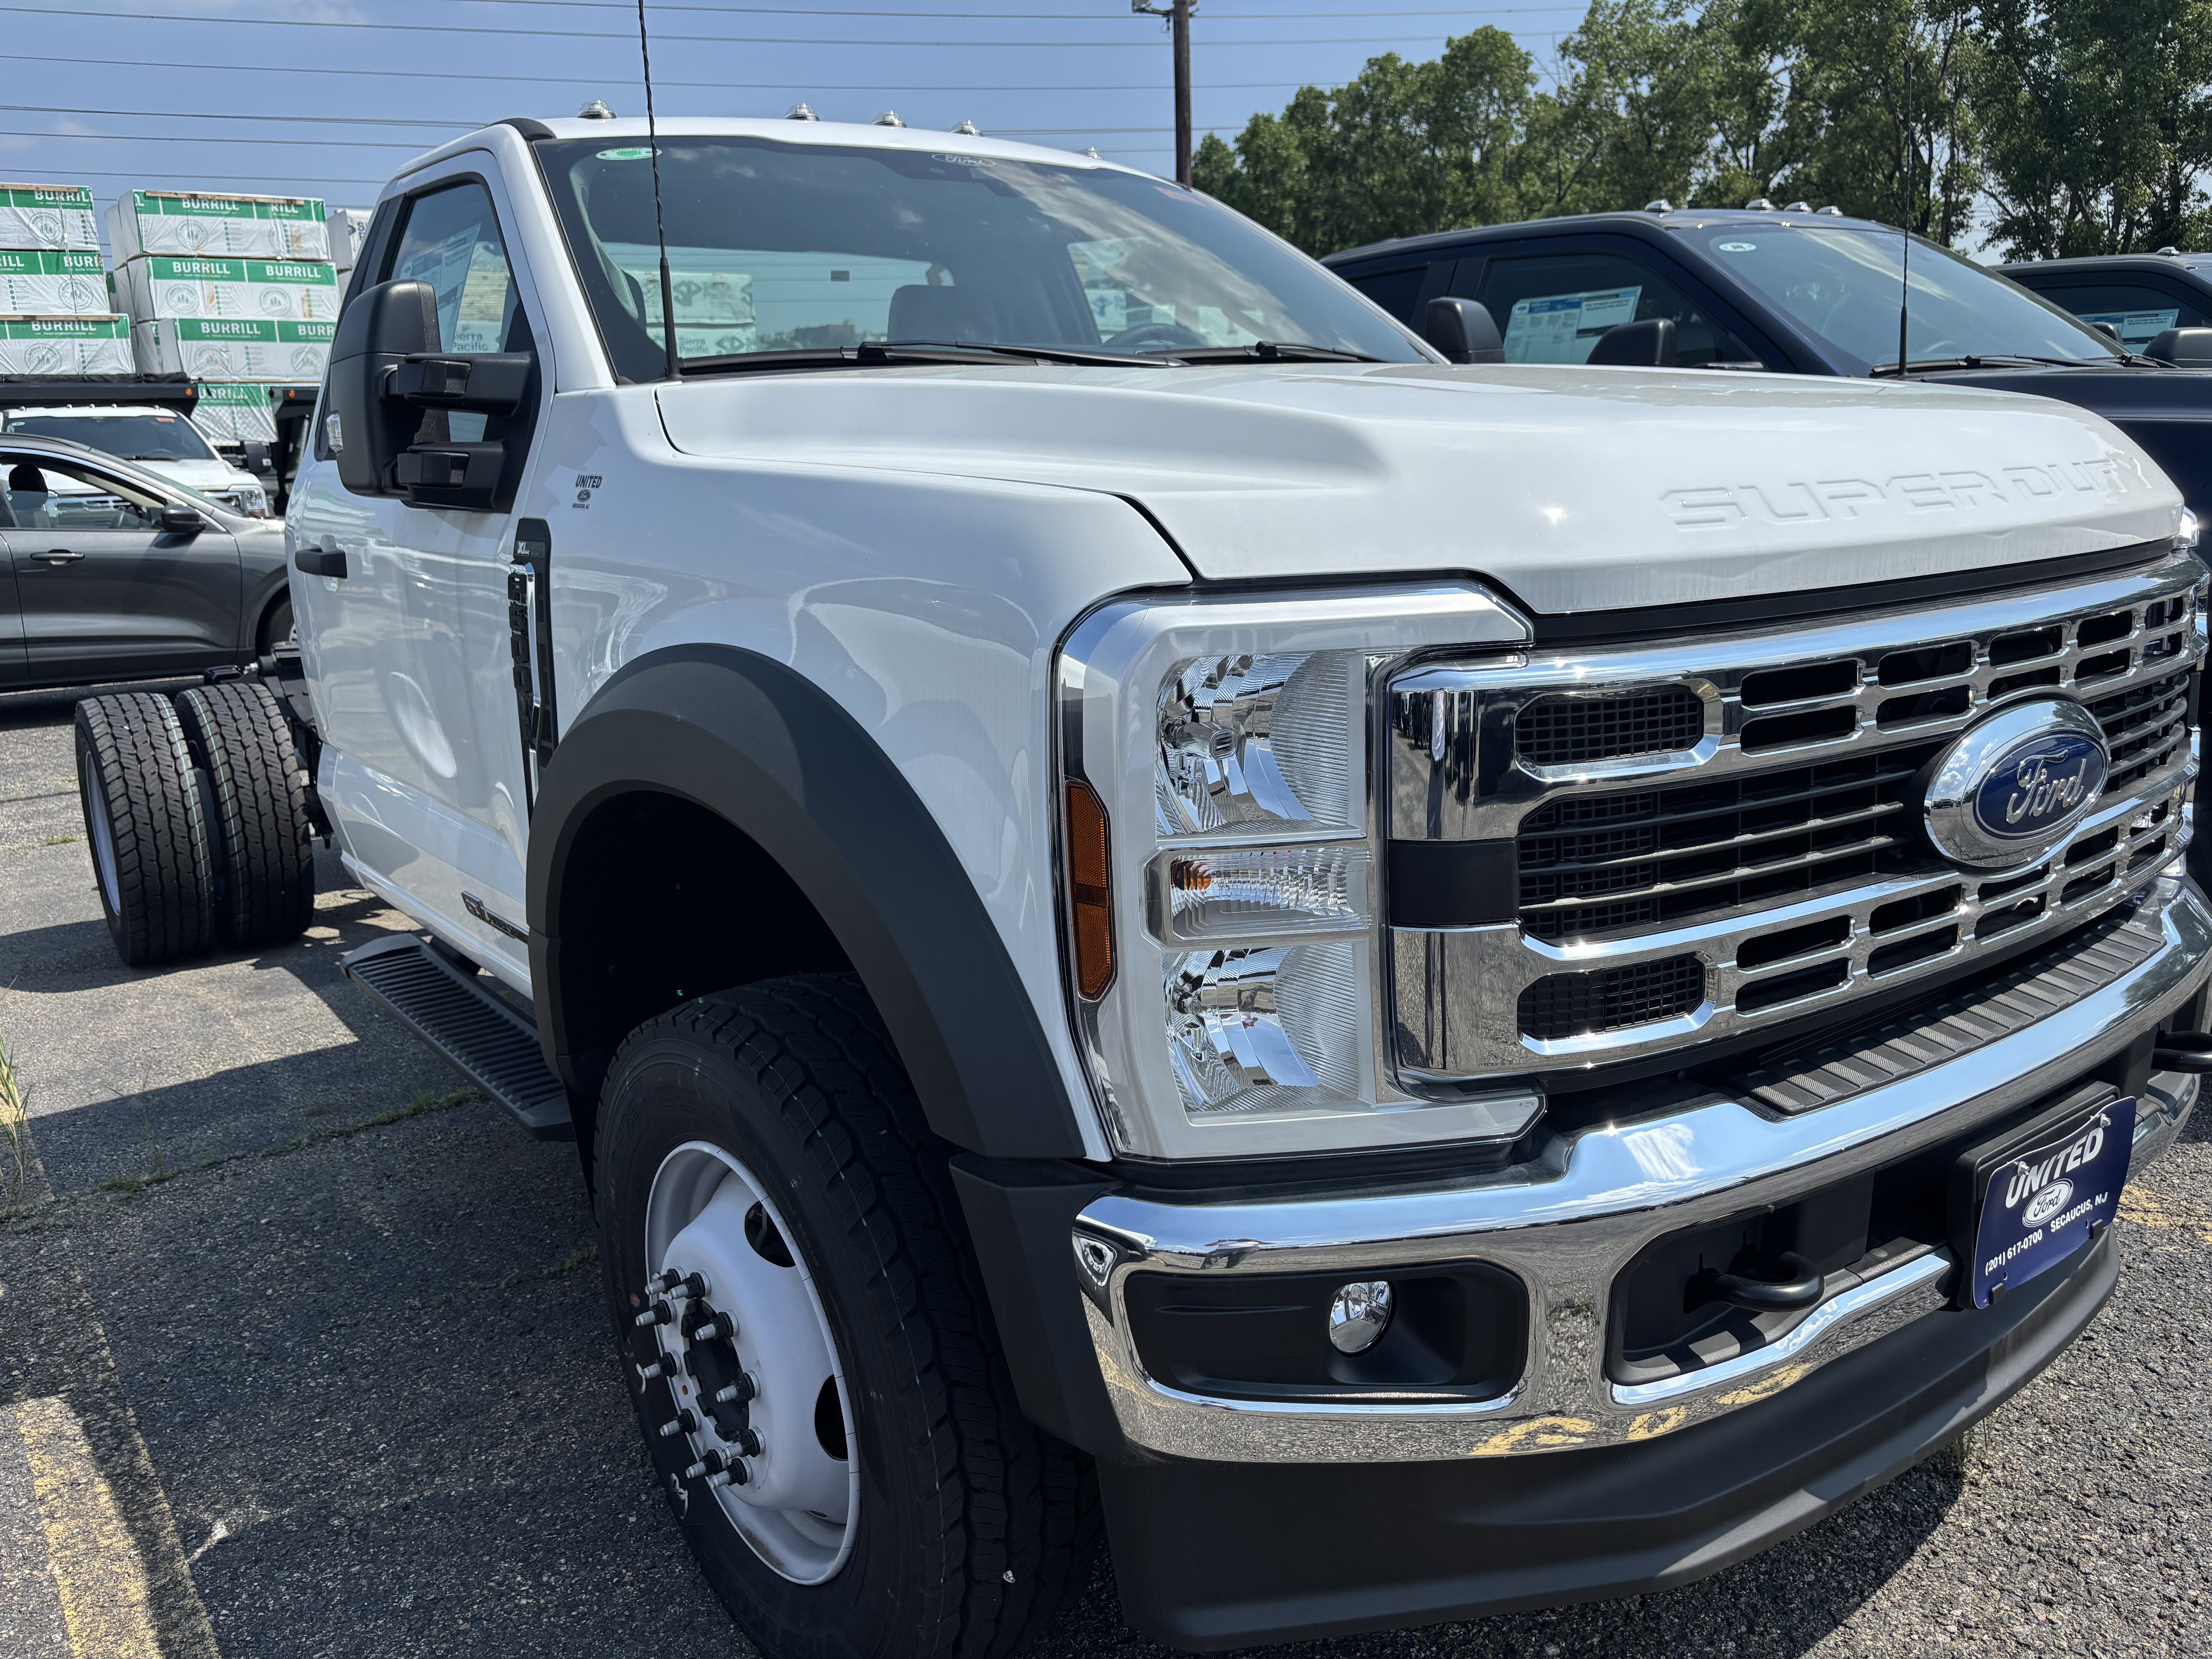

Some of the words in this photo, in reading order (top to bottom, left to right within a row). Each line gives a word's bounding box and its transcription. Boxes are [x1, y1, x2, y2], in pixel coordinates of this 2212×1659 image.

[945, 155, 986, 165] Ford
[173, 261, 230, 274] BURRILL
[266, 265, 321, 278] BURRILL
[31, 321, 97, 331] BURRILL
[201, 322, 261, 335] BURRILL
[455, 333, 483, 341] ierra
[575, 474, 602, 488] UNITED
[1660, 471, 2008, 531] SUPER
[2002, 457, 2152, 498] DUTY
[517, 541, 530, 555] XL
[2006, 748, 2087, 824] Ford
[2005, 1127, 2104, 1208] UNITED
[2033, 1188, 2062, 1218] Ford
[1985, 1252, 2006, 1276] (201)
[2007, 1229, 2043, 1259] 617-0700
[2051, 1199, 2093, 1233] SECAUCUS,
[2095, 1192, 2109, 1206] NJ
